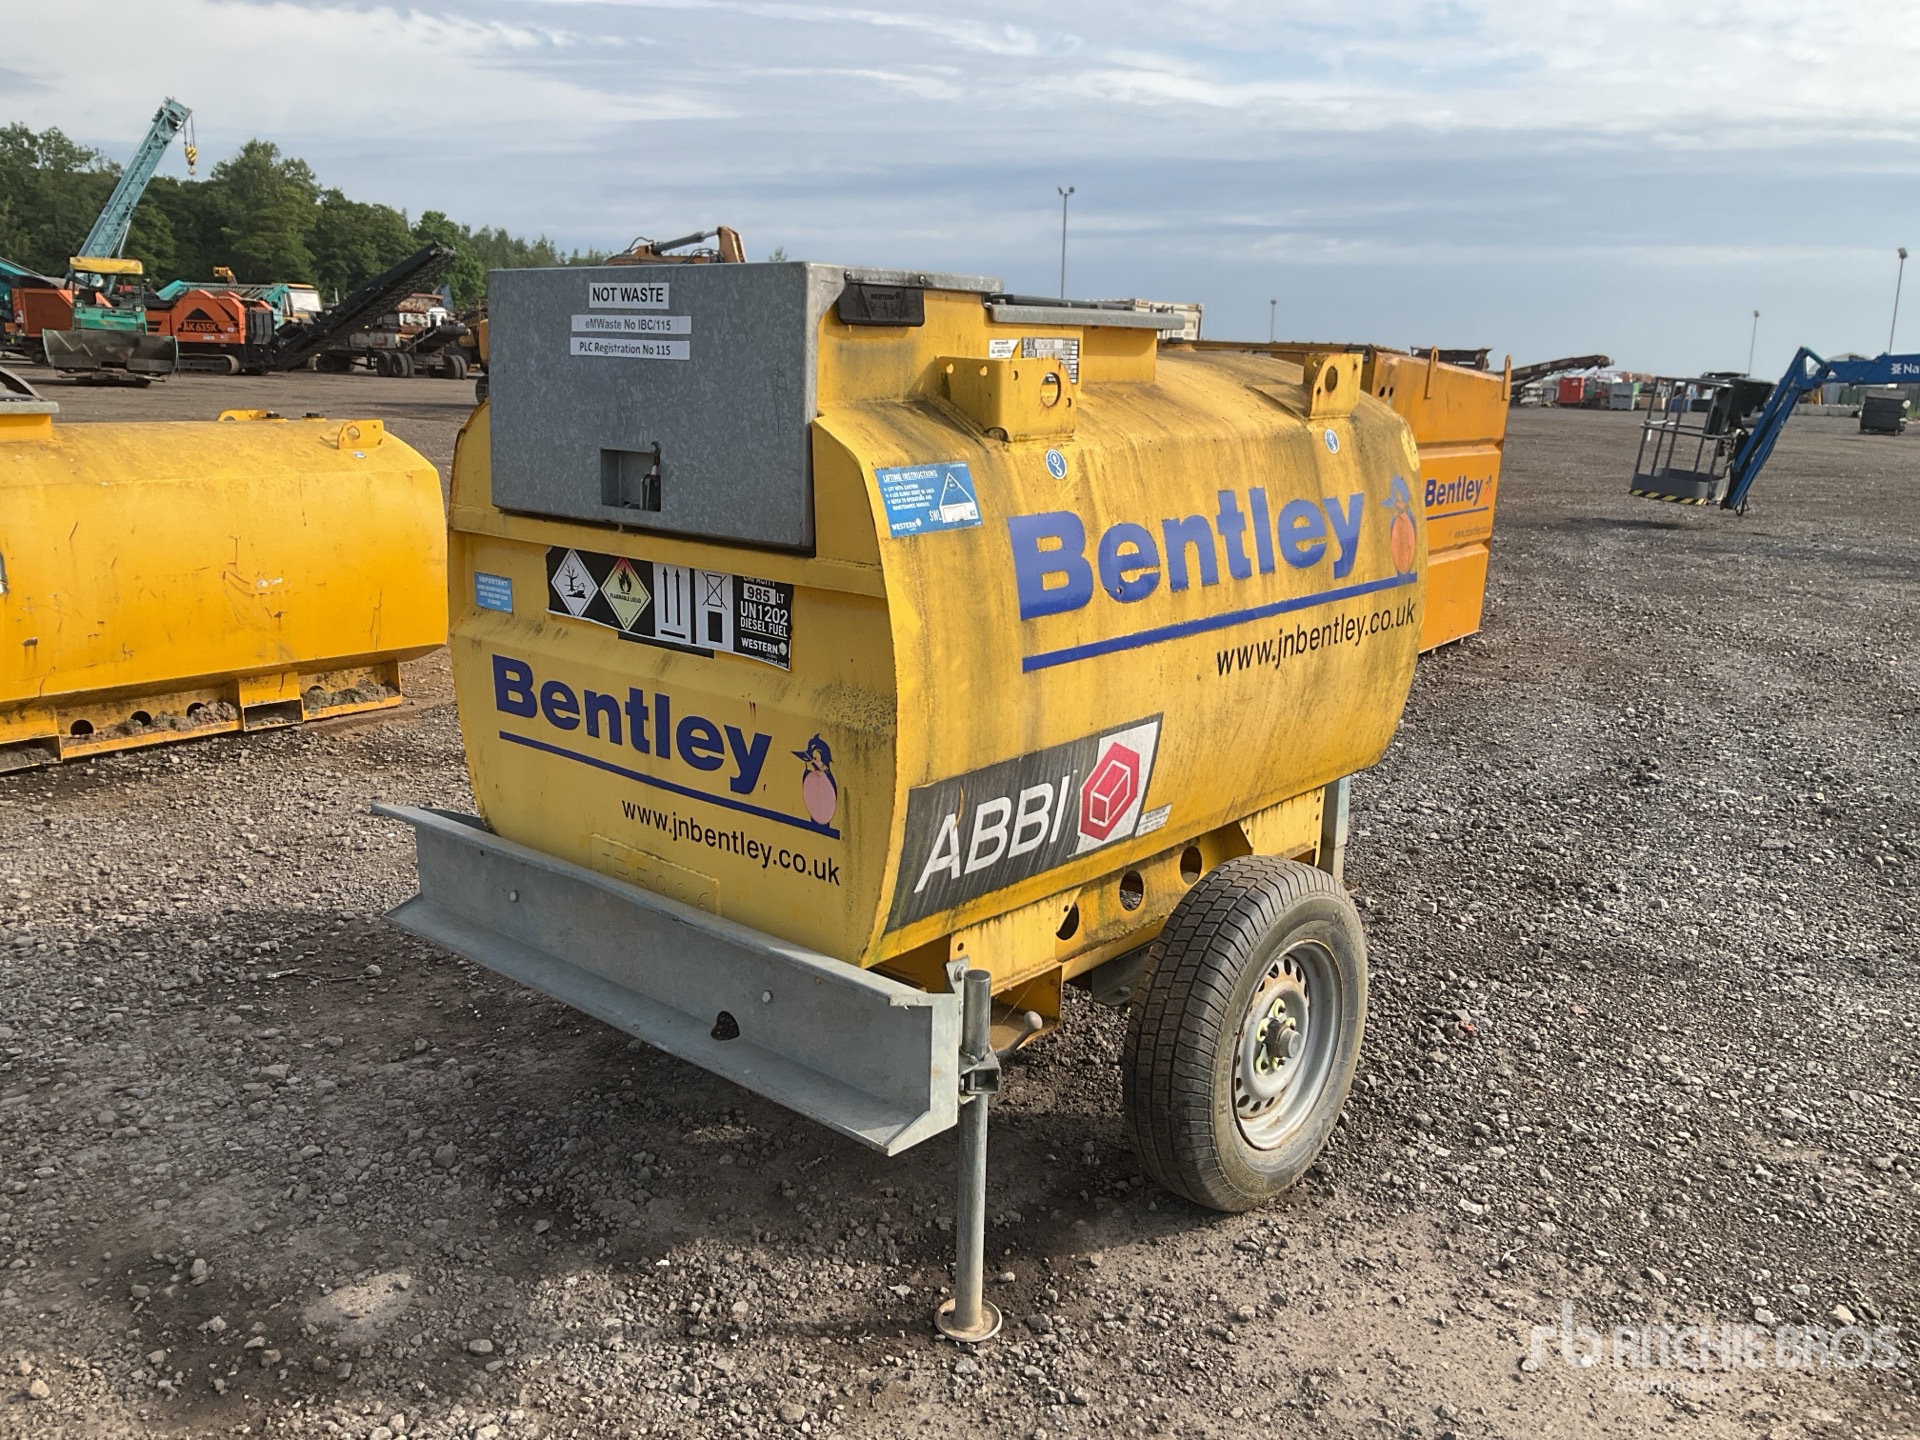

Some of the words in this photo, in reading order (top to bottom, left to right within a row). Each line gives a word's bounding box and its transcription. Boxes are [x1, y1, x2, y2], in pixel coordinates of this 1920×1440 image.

[592, 287, 617, 302] NOT
[620, 287, 664, 303] WASTE
[585, 318, 622, 330] eMWaste
[624, 319, 636, 330] No
[637, 319, 672, 332] IBC/115
[579, 341, 593, 353] PLC
[594, 343, 641, 356] Registration
[642, 344, 654, 356] No
[656, 345, 671, 357] 115
[1903, 363, 1920, 375] Na
[1424, 475, 1484, 508] Bentley
[1007, 487, 1364, 621] Bentley
[609, 592, 630, 602] FLAMMABLE
[747, 586, 771, 603] 985
[776, 592, 785, 604] LT
[740, 600, 788, 627] UN1202
[740, 616, 767, 633] DIESEL
[768, 622, 788, 638] FUEL
[1216, 598, 1416, 677] www.jnbentley.co.uk
[741, 636, 778, 655] WESTERN
[492, 654, 772, 795] Bentley
[622, 800, 840, 886] www.jnbentley.co.uk
[914, 775, 1070, 893] ABBI
